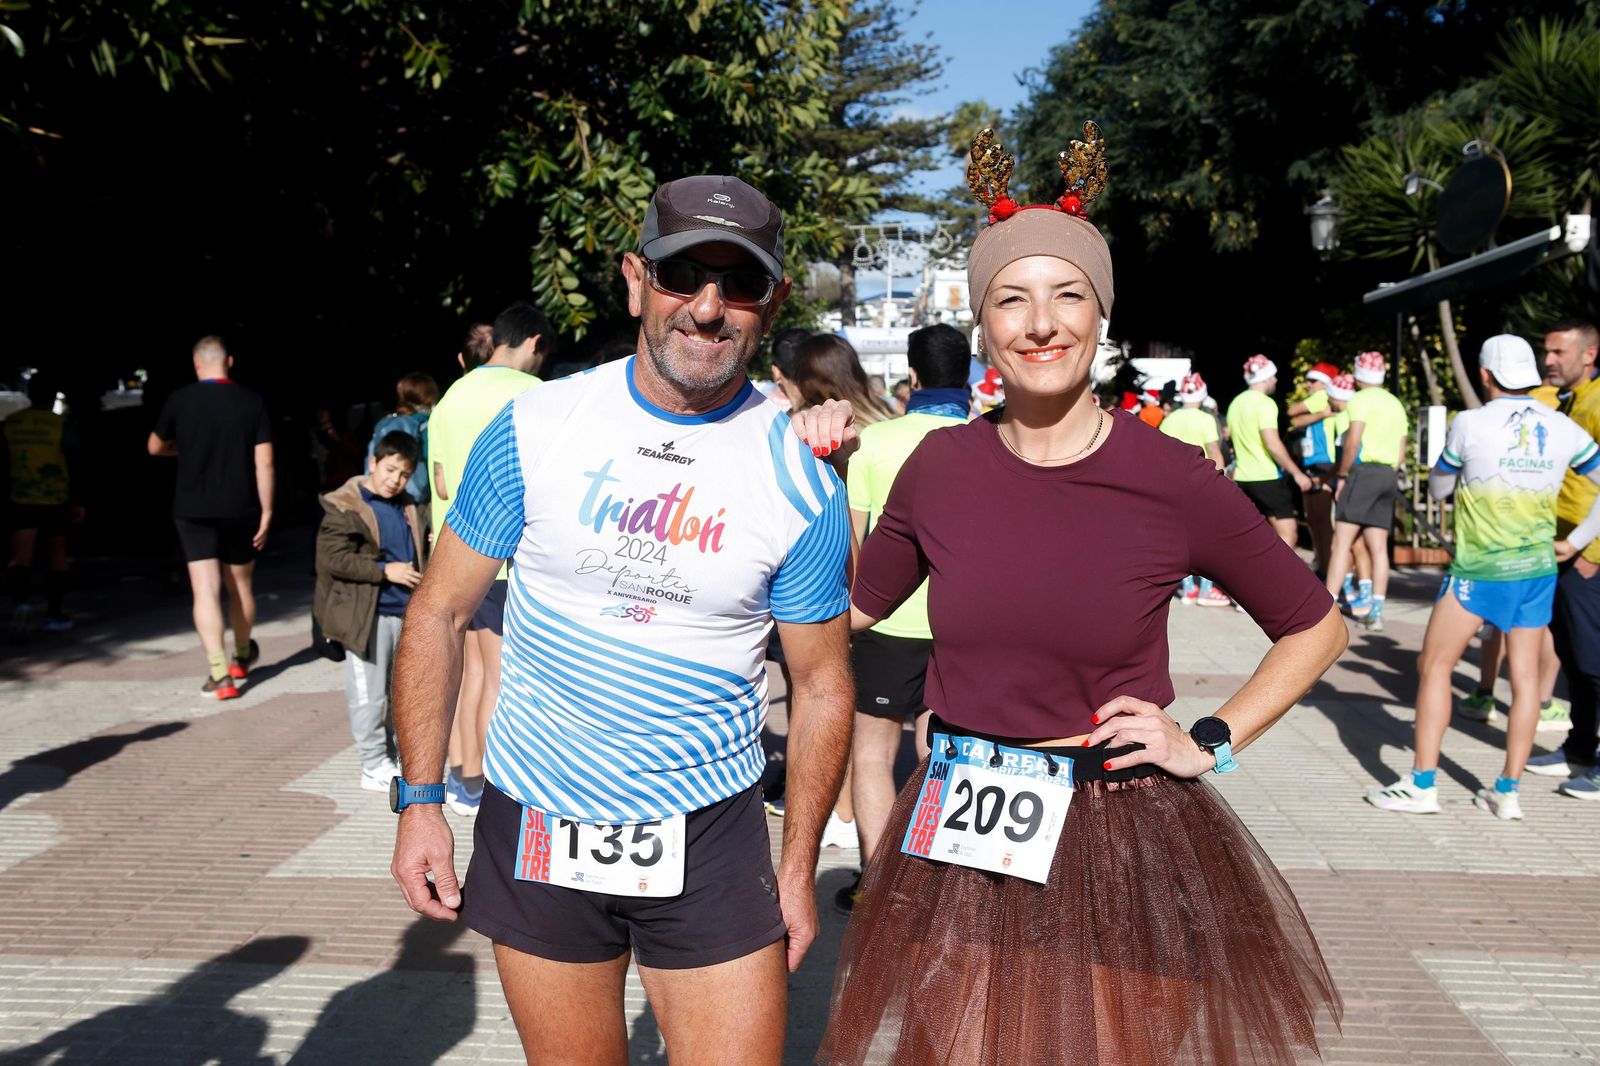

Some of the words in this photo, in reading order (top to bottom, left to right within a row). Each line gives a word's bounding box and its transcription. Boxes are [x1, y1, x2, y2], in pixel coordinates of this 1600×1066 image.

[636, 446, 696, 466] TEAMERGY
[1499, 458, 1554, 470] FACINAS
[614, 535, 667, 566] 2024
[574, 548, 698, 593] Deportes
[613, 591, 658, 604] ANIVERSARIO
[930, 761, 950, 781] SAN
[922, 780, 944, 804] SIL
[526, 808, 547, 832] SIL
[915, 804, 943, 832] VES
[944, 778, 1044, 843] 209
[524, 829, 551, 857] VES
[559, 818, 664, 867] 135
[907, 827, 936, 857] TRE
[521, 854, 551, 882] TRE
